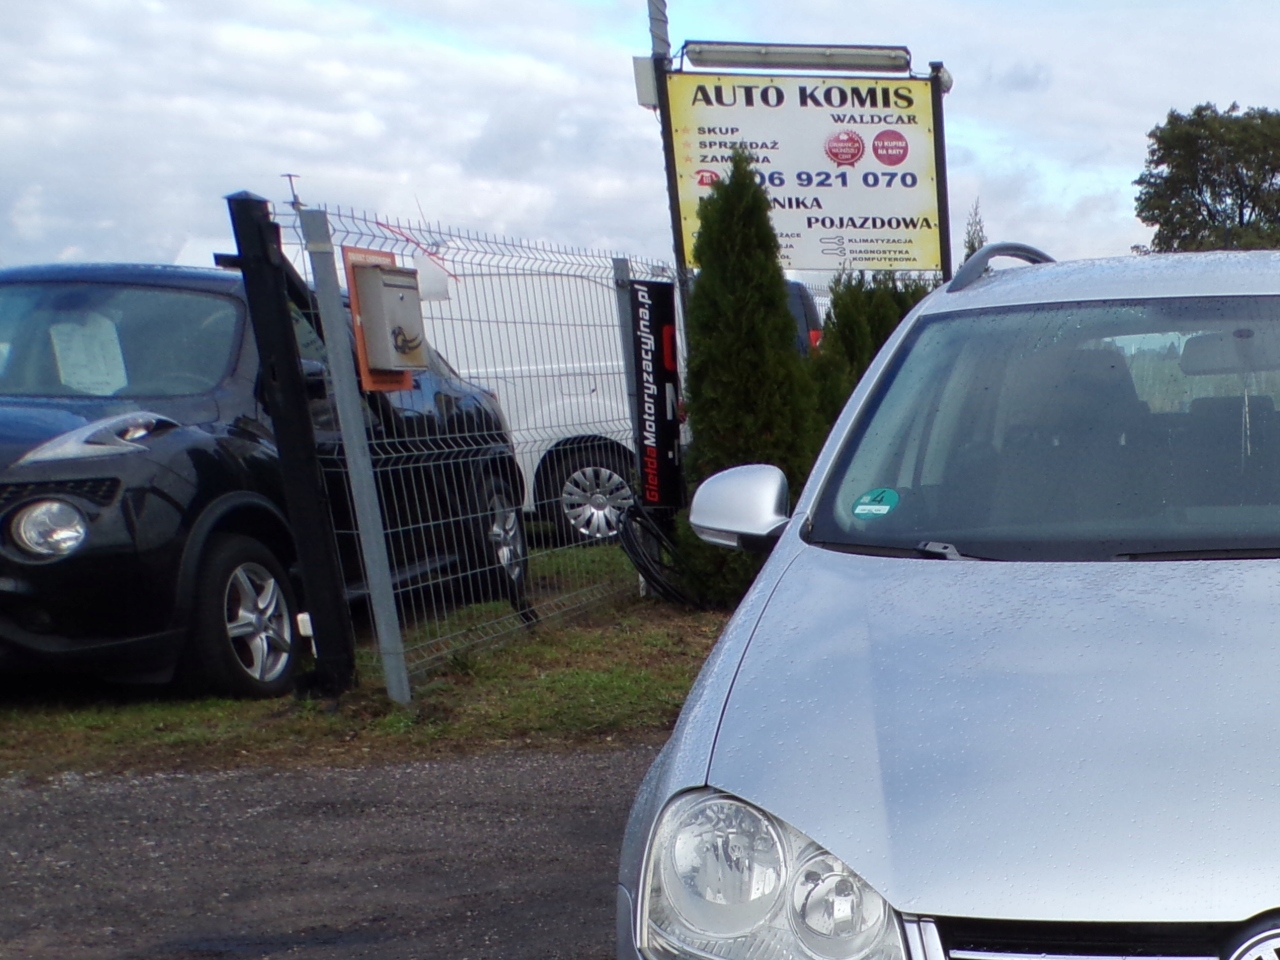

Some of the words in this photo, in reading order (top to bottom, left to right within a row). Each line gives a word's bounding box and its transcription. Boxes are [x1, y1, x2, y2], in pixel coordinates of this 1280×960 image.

[692, 84, 785, 107] AUTO
[798, 86, 915, 109] KOMIS
[830, 113, 919, 125] WALDCAR
[697, 126, 740, 135] SKUP
[698, 140, 780, 150] SPRZEDAŻ
[699, 154, 771, 164] ZAMNA
[795, 171, 848, 188] 921
[862, 172, 918, 188] 070
[806, 216, 933, 230] POJAZDOWA
[872, 490, 887, 504] 4
